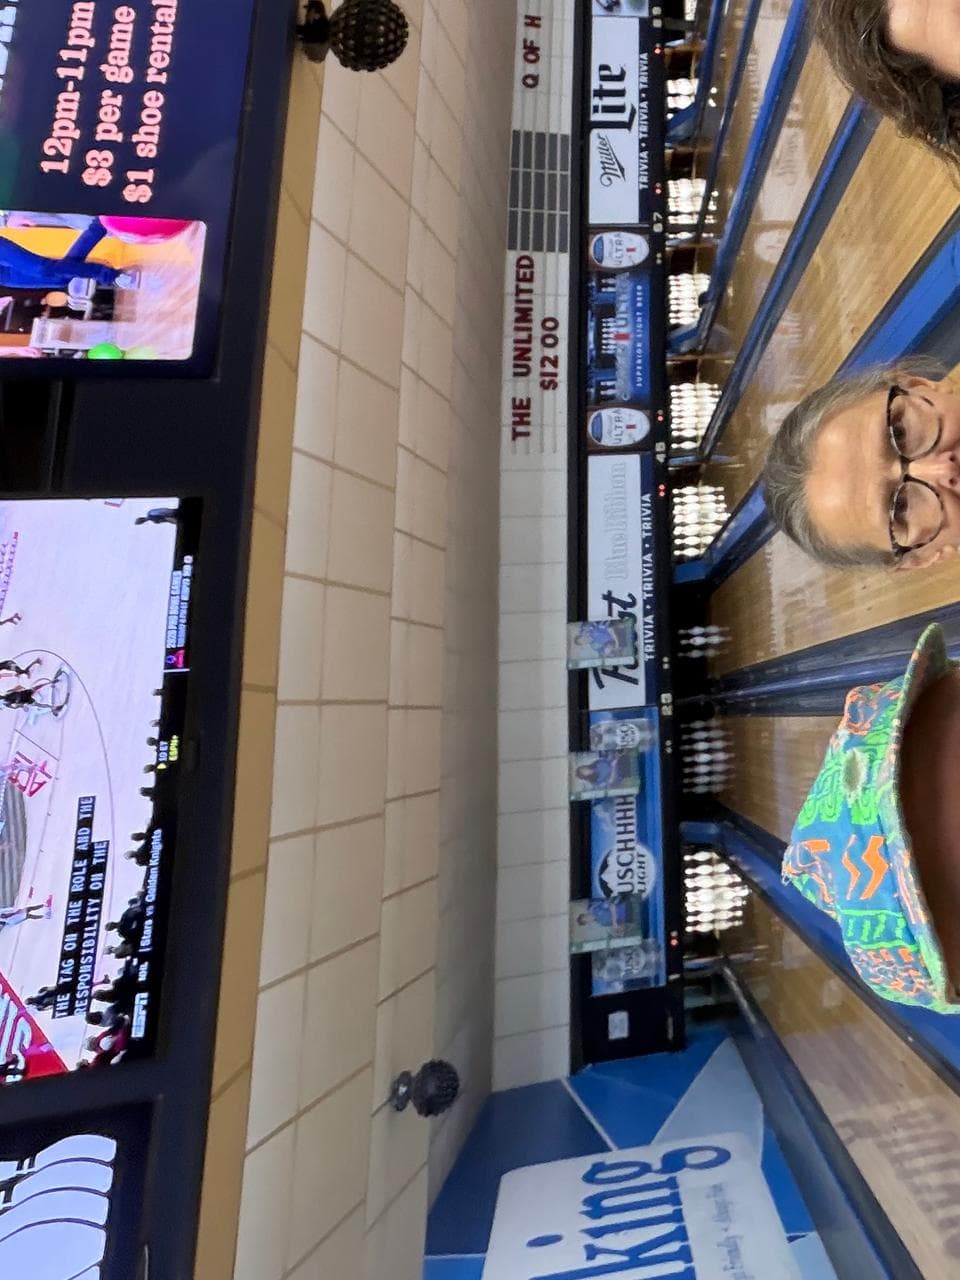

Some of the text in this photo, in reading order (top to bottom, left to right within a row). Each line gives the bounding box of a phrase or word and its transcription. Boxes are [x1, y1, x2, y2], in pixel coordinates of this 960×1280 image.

[40, 1, 96, 174] 12pm-11pm
[81, 5, 136, 187] $3 per game
[521, 14, 542, 89] Q OF H
[131, 90, 164, 158] shoe
[590, 63, 637, 187] Miller Lite
[638, 52, 649, 190] TRIVIA TRIVIA TRIVIA
[122, 168, 154, 203] $1
[511, 254, 535, 441] THE UNLIMITED
[635, 311, 644, 338] LIGHT
[635, 341, 644, 387] SUPERIOR
[640, 493, 656, 661] TRIVIA TRIVIA TRIVIA
[55, 796, 93, 1018] THE TAG ON THE ROLE AND THE
[145, 866, 160, 902] Golden
[148, 828, 163, 866] Knights
[635, 852, 647, 894] LIGHT
[74, 841, 108, 1015] RESPONSIBILITY ON THE
[526, 1145, 731, 1280] king
